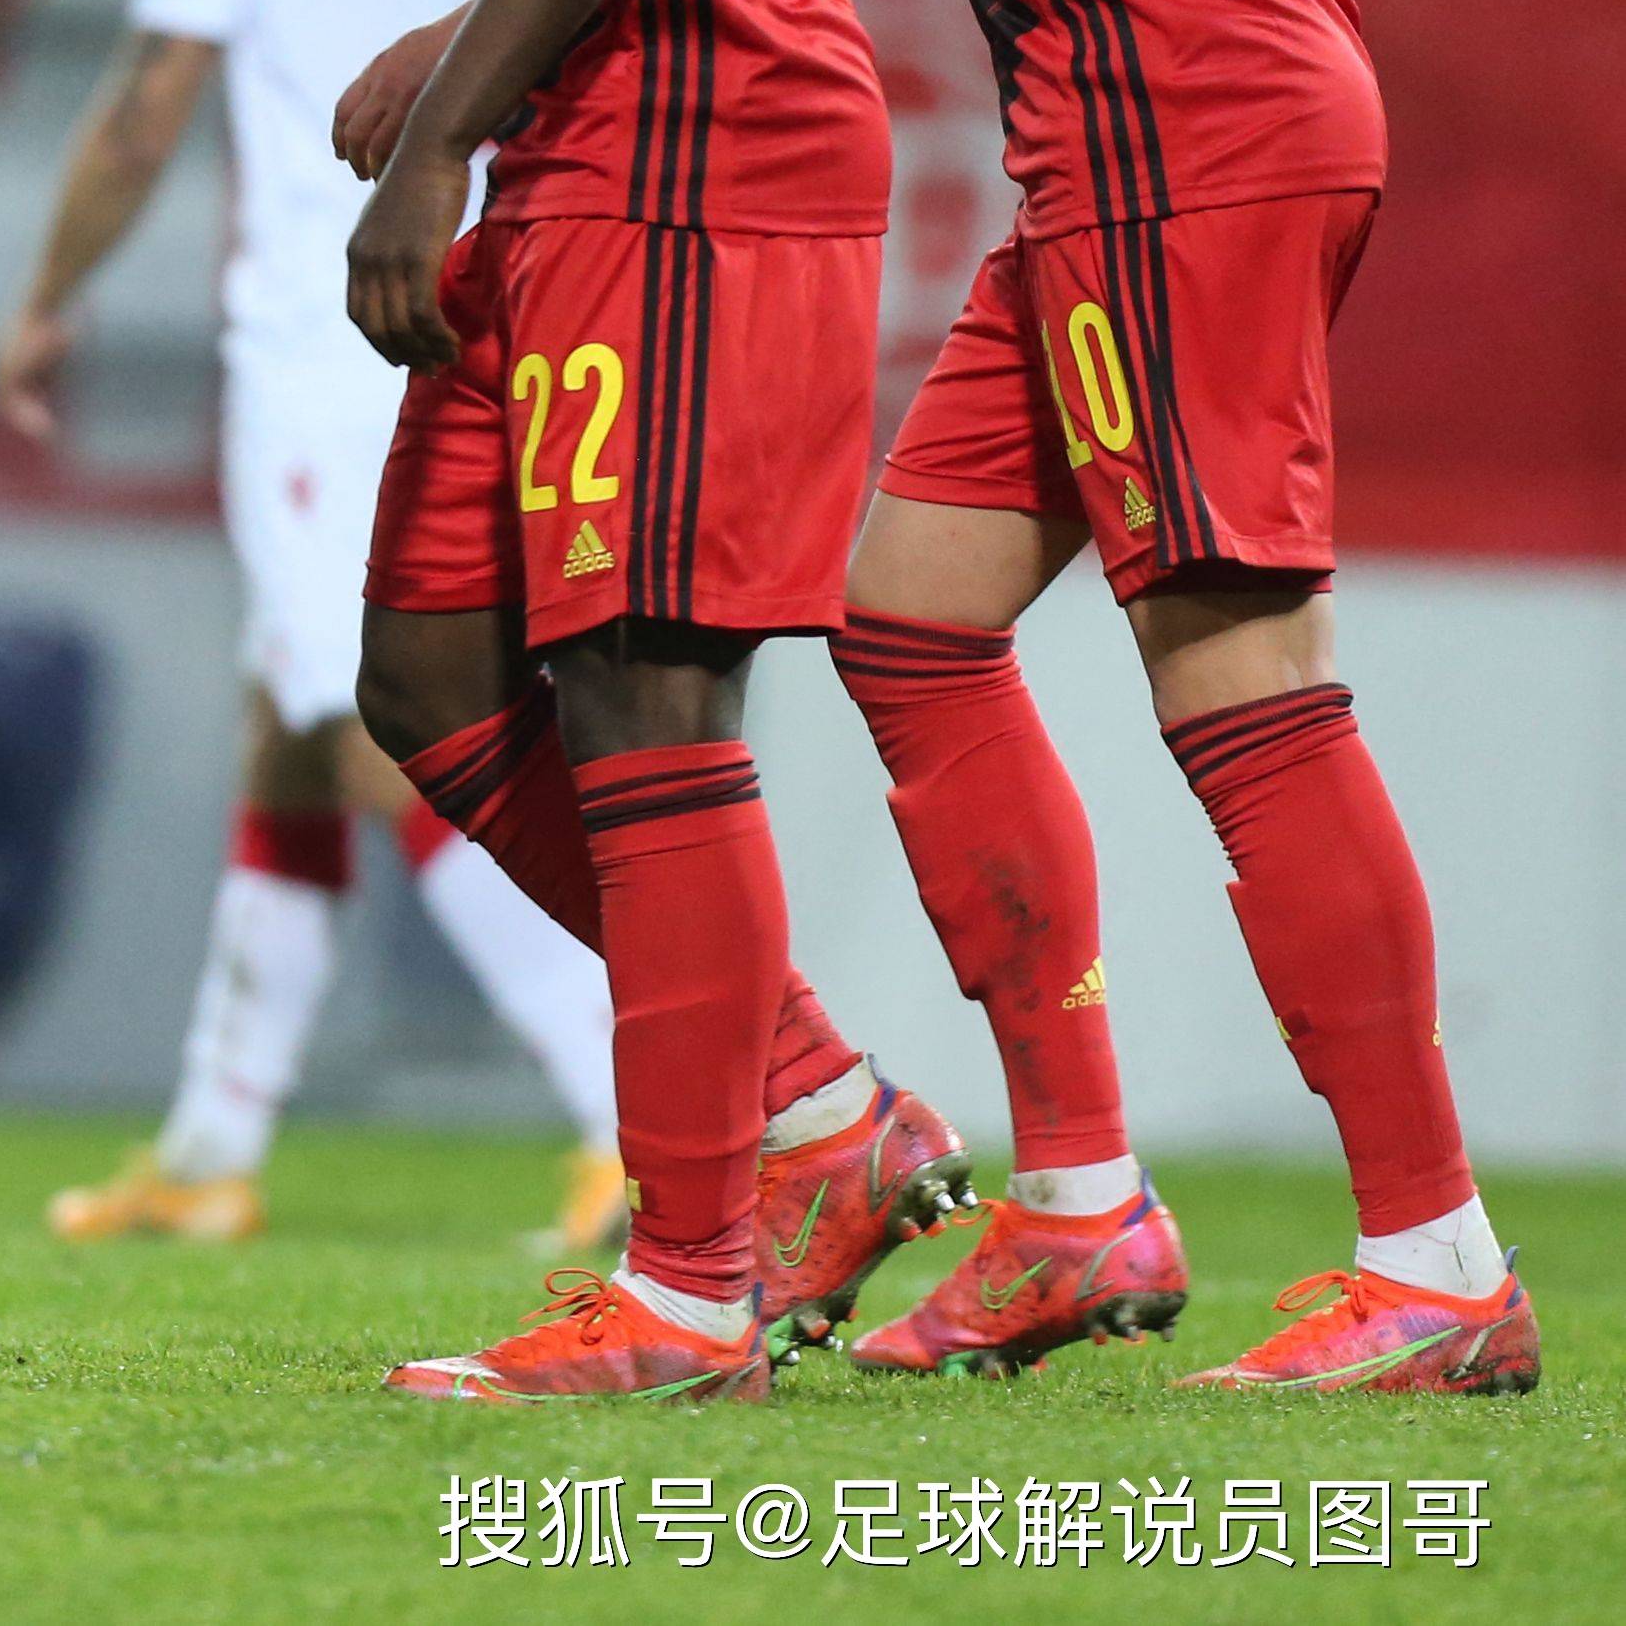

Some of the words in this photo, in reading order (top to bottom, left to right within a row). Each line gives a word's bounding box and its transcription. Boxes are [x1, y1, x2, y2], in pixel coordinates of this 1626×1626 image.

[512, 342, 624, 513] 22
[1041, 301, 1134, 470] 10
[563, 551, 615, 579] adidas
